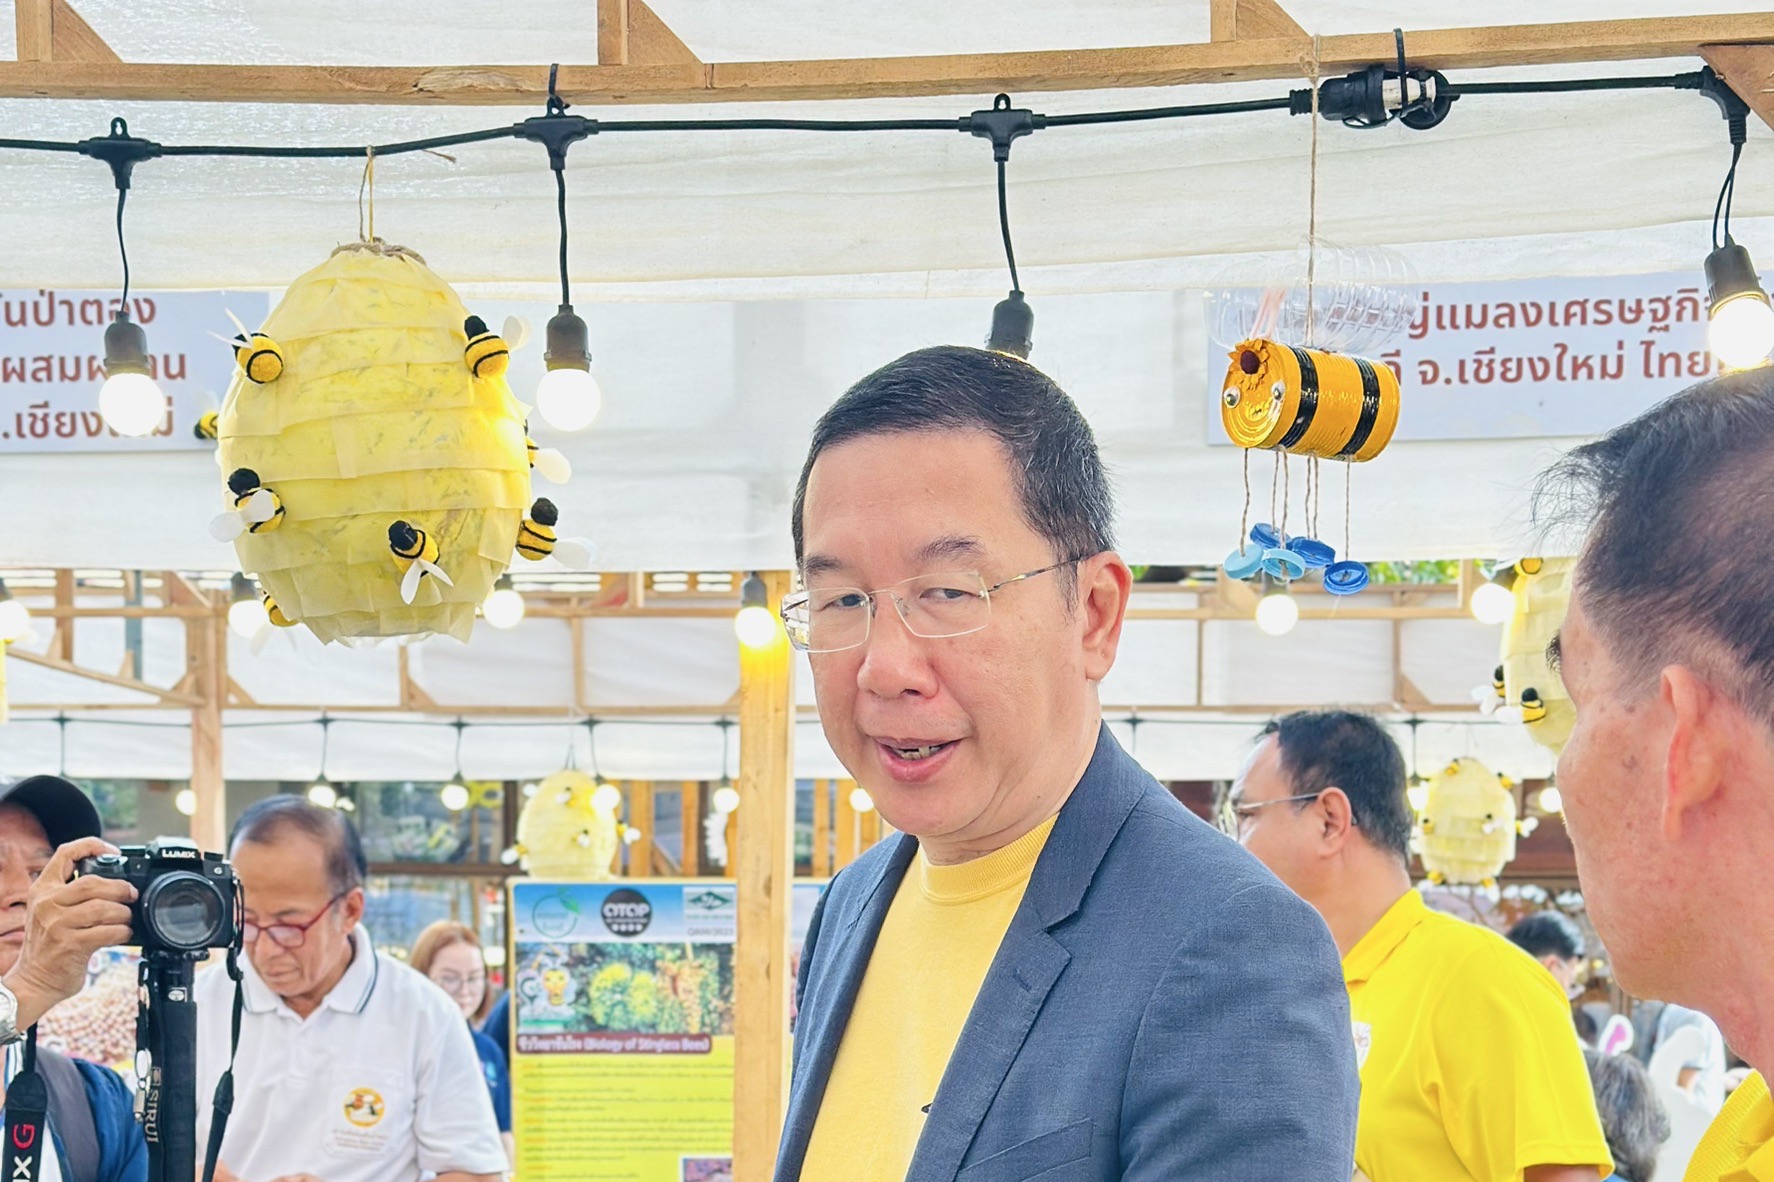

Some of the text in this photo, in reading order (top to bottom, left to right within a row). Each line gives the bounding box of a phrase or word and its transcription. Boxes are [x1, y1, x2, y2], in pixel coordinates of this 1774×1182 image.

[1418, 341, 1624, 386] จ.เชียงใหม่
[1640, 340, 1725, 378] ไทย
[162, 849, 196, 858] LUMIX
[144, 1089, 160, 1143] SIRUI
[13, 1123, 36, 1149] G
